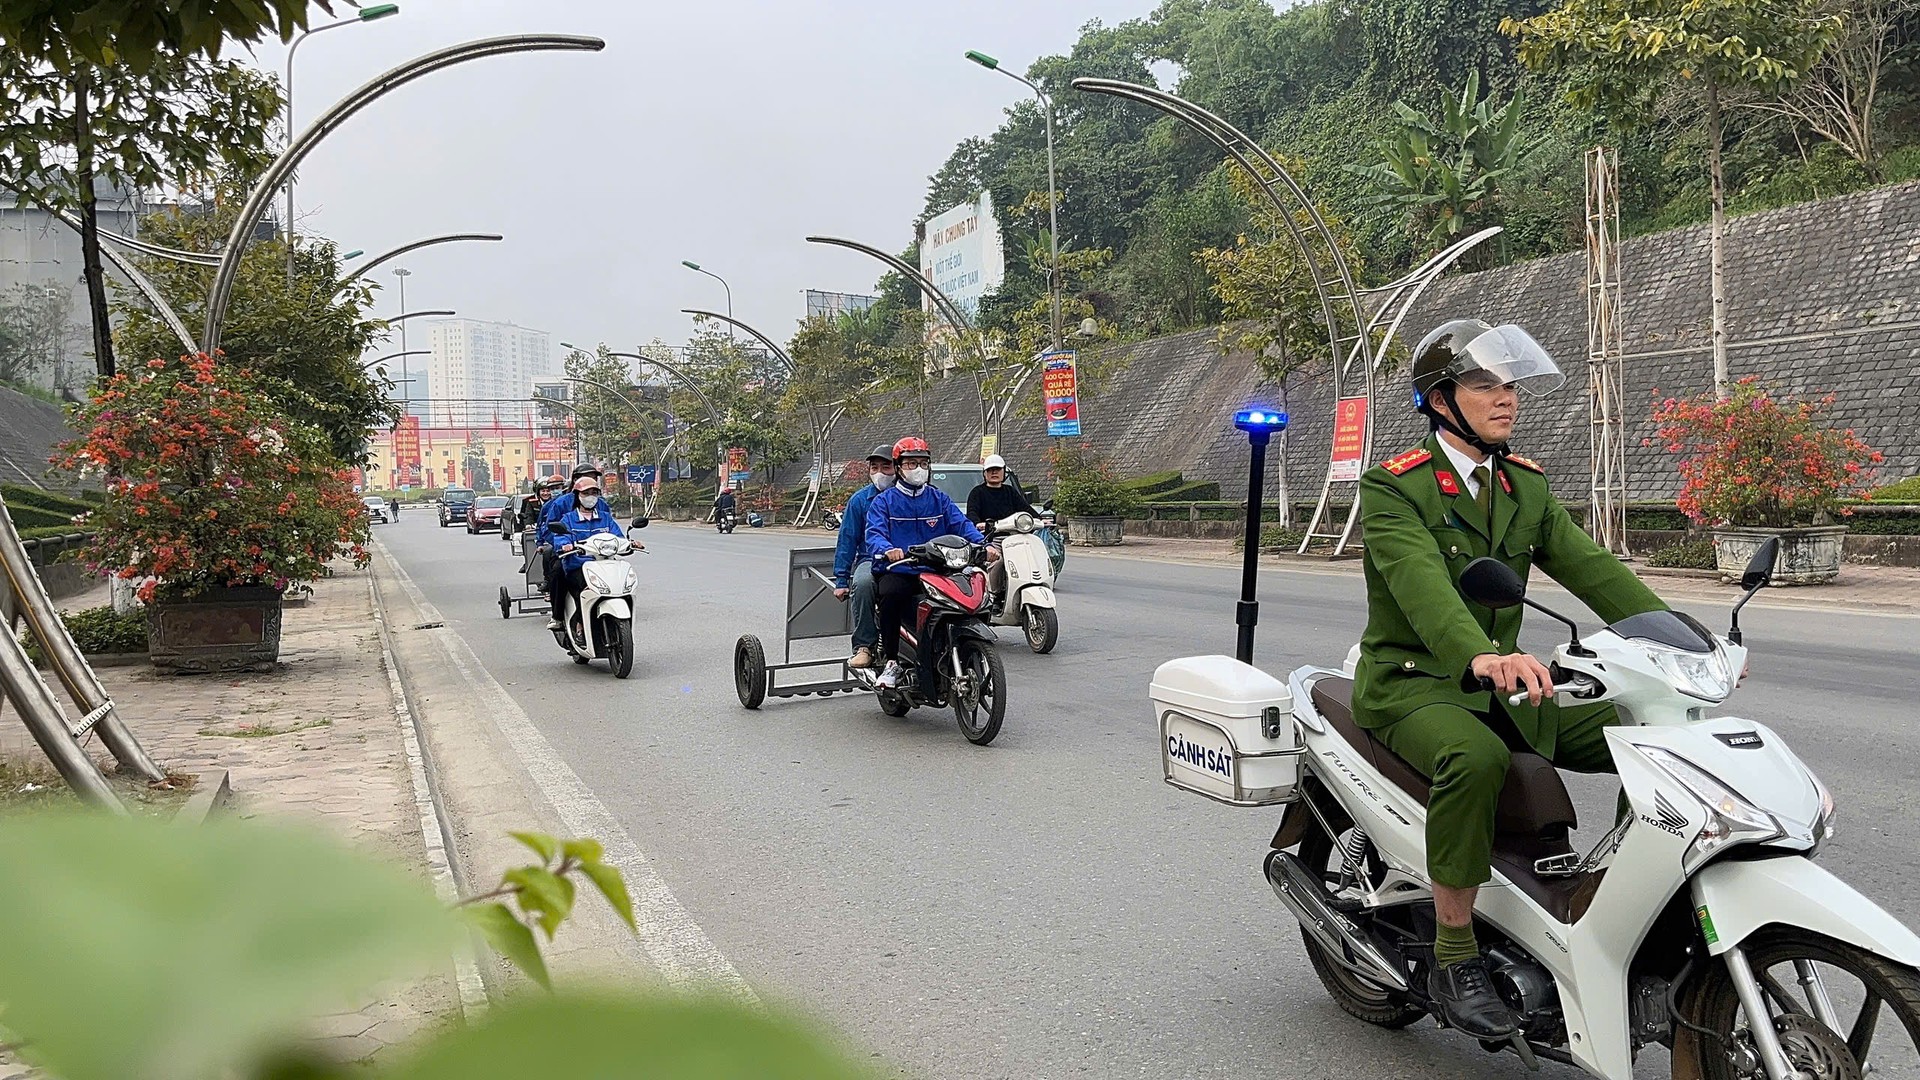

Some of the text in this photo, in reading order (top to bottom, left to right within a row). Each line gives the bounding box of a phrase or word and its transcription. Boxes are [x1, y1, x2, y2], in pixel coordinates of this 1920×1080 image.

[945, 221, 965, 244] CHUNG
[967, 215, 979, 235] TAY
[957, 271, 967, 291] VIỆT
[967, 269, 979, 286] NAM
[1168, 733, 1232, 778] CẢNH SÁT
[1640, 814, 1685, 840] HONDA
